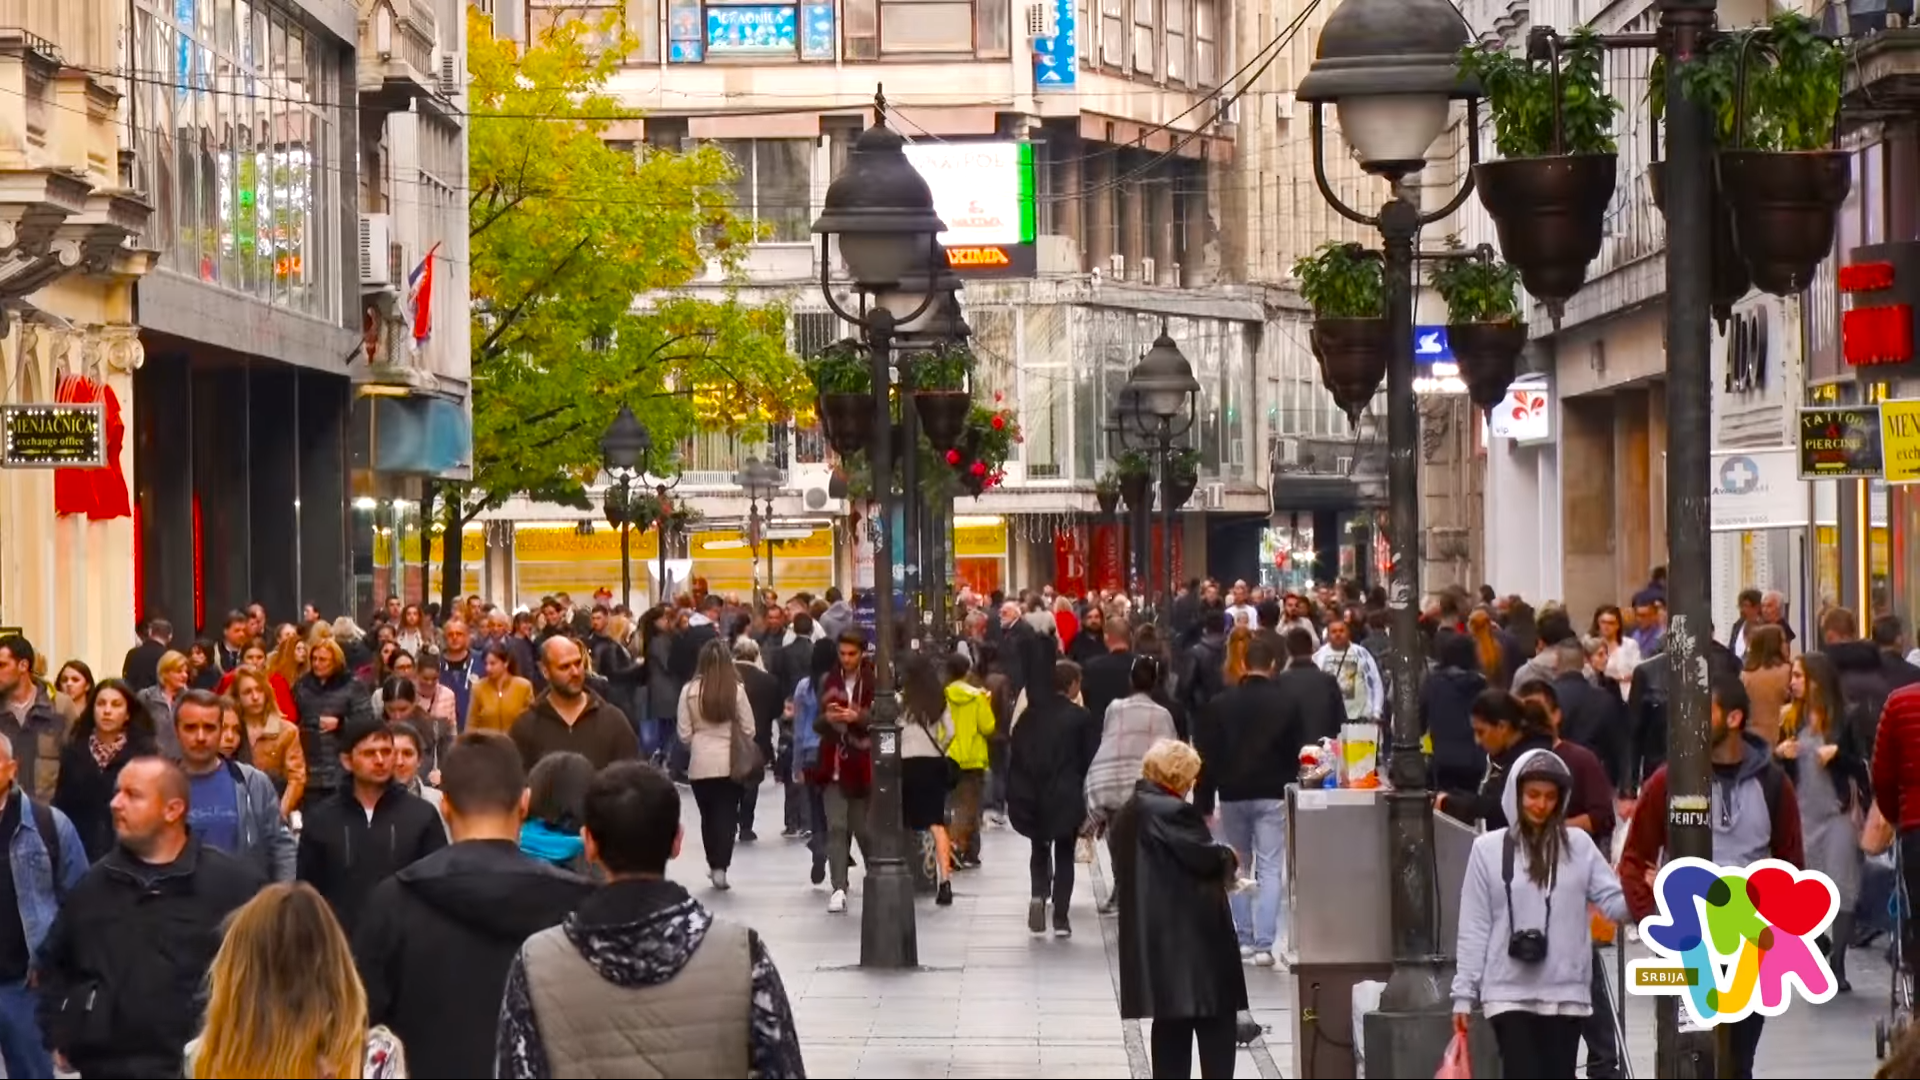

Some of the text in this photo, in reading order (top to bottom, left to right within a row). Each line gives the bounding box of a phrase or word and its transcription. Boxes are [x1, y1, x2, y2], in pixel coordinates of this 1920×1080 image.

[1803, 413, 1864, 428] TATTOO
[17, 436, 84, 448] exchange office
